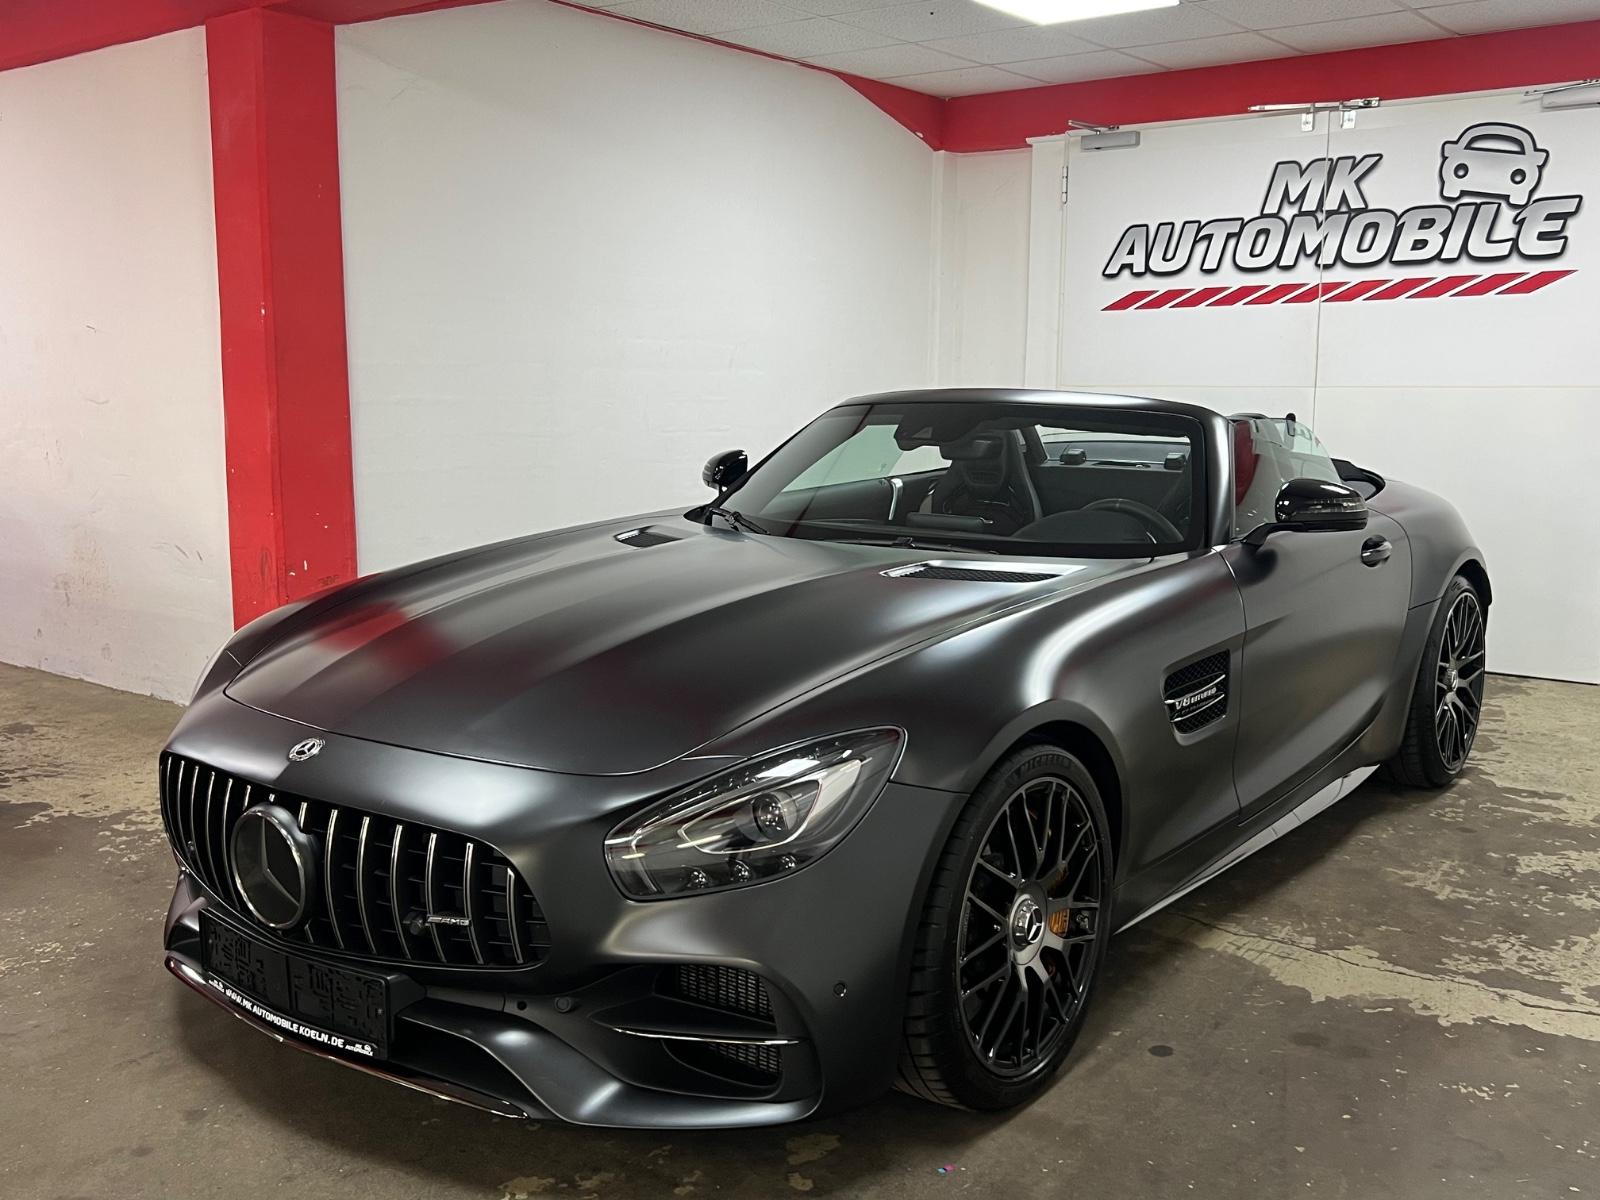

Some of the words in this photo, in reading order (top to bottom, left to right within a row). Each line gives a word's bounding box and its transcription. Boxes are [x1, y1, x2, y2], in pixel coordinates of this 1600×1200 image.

[1261, 152, 1384, 214] MK
[1102, 194, 1584, 277] AUTOMOBILE
[252, 1006, 299, 1033] AUTOMOBILE
[299, 1024, 345, 1048] KOELN.DE
